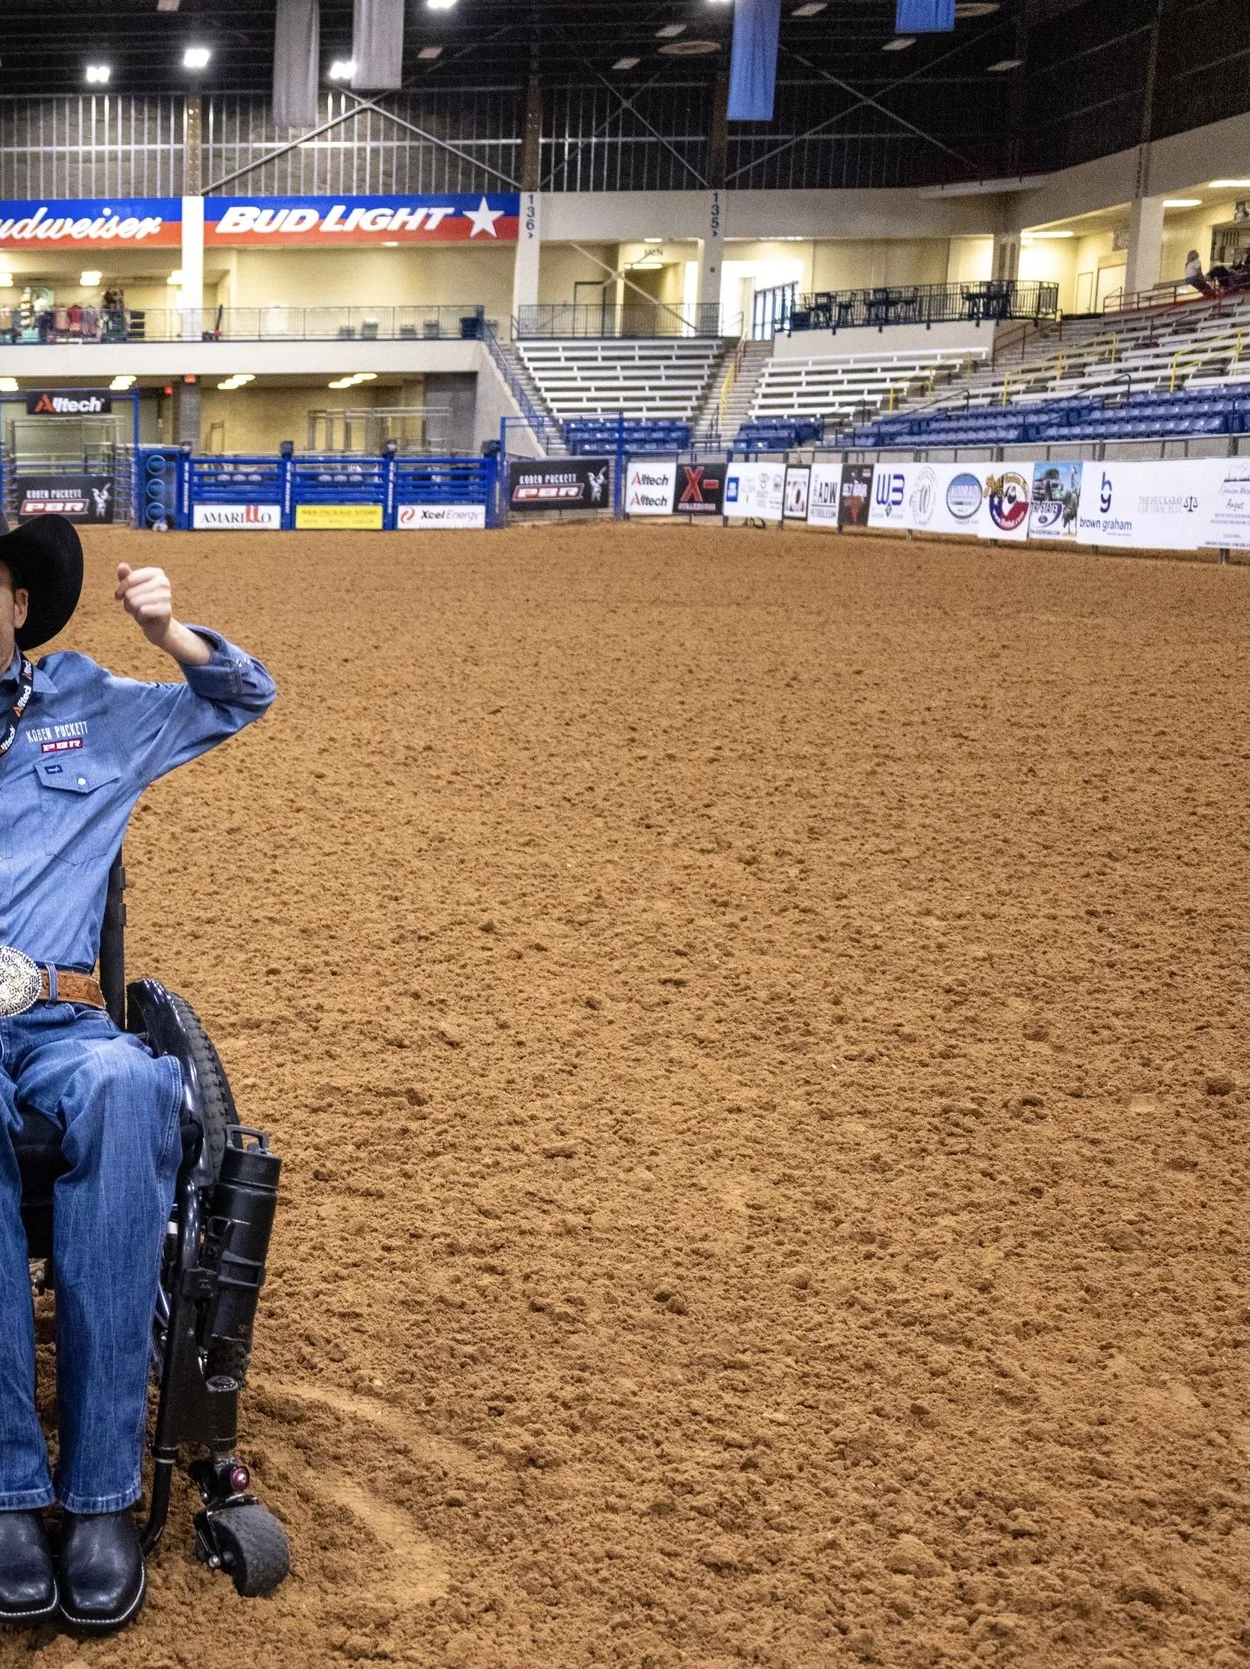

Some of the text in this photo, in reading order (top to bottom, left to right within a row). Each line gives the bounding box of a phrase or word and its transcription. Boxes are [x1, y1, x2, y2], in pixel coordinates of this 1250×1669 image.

[215, 205, 455, 233] BUD LIGHT
[526, 194, 535, 230] 136
[711, 192, 720, 228] 135
[35, 393, 102, 412] Alltech
[631, 471, 669, 486] Alltech
[518, 487, 579, 498] PBR
[630, 491, 668, 507] Alltech
[819, 481, 838, 504] ADW
[25, 502, 84, 512] PBR
[202, 505, 272, 523] AMARILLO
[1080, 516, 1132, 532] brown graham
[26, 721, 88, 743] KOBEN PUCKETT
[43, 740, 81, 752] PBR
